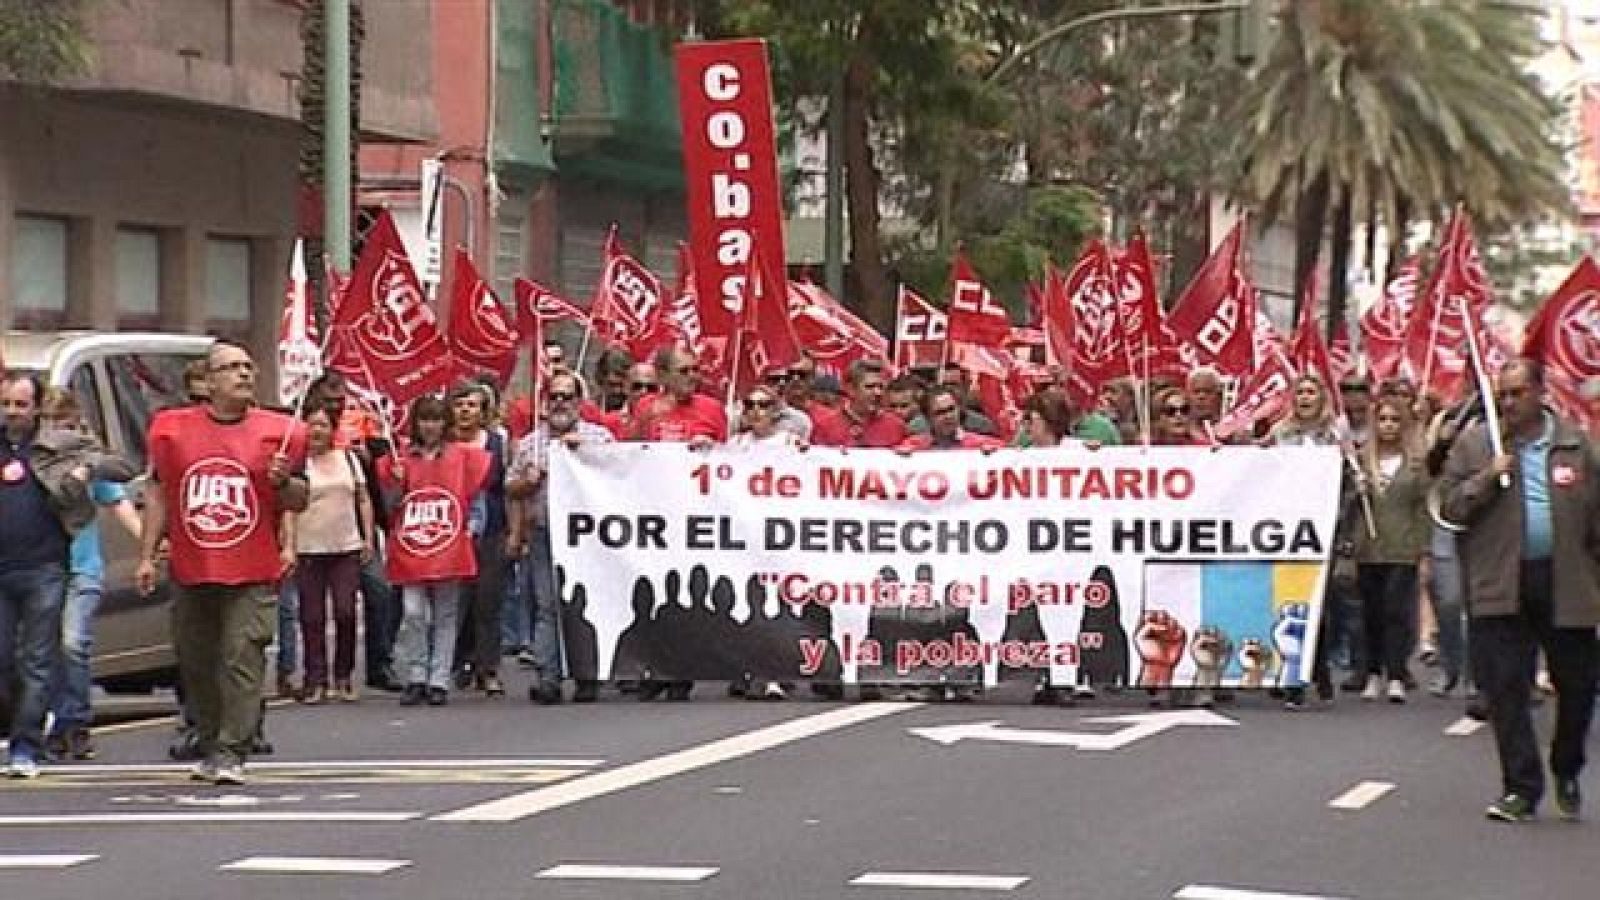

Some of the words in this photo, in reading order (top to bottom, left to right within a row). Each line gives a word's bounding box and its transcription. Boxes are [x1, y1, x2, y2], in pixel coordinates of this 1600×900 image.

[187, 474, 248, 511] UGT
[748, 466, 802, 498] de
[818, 467, 950, 501] MAYO
[967, 467, 1195, 501] UNITARIO
[403, 498, 452, 526] UGT
[567, 513, 668, 549] POR
[686, 515, 747, 550] EL
[764, 518, 1009, 554] DERECHO
[1028, 519, 1093, 554] DE
[1112, 519, 1323, 554] HUELGA
[949, 573, 989, 608] el
[1006, 577, 1111, 612] paro
[799, 637, 827, 677] y
[842, 632, 883, 667] la
[896, 632, 1103, 677] pobreza"
